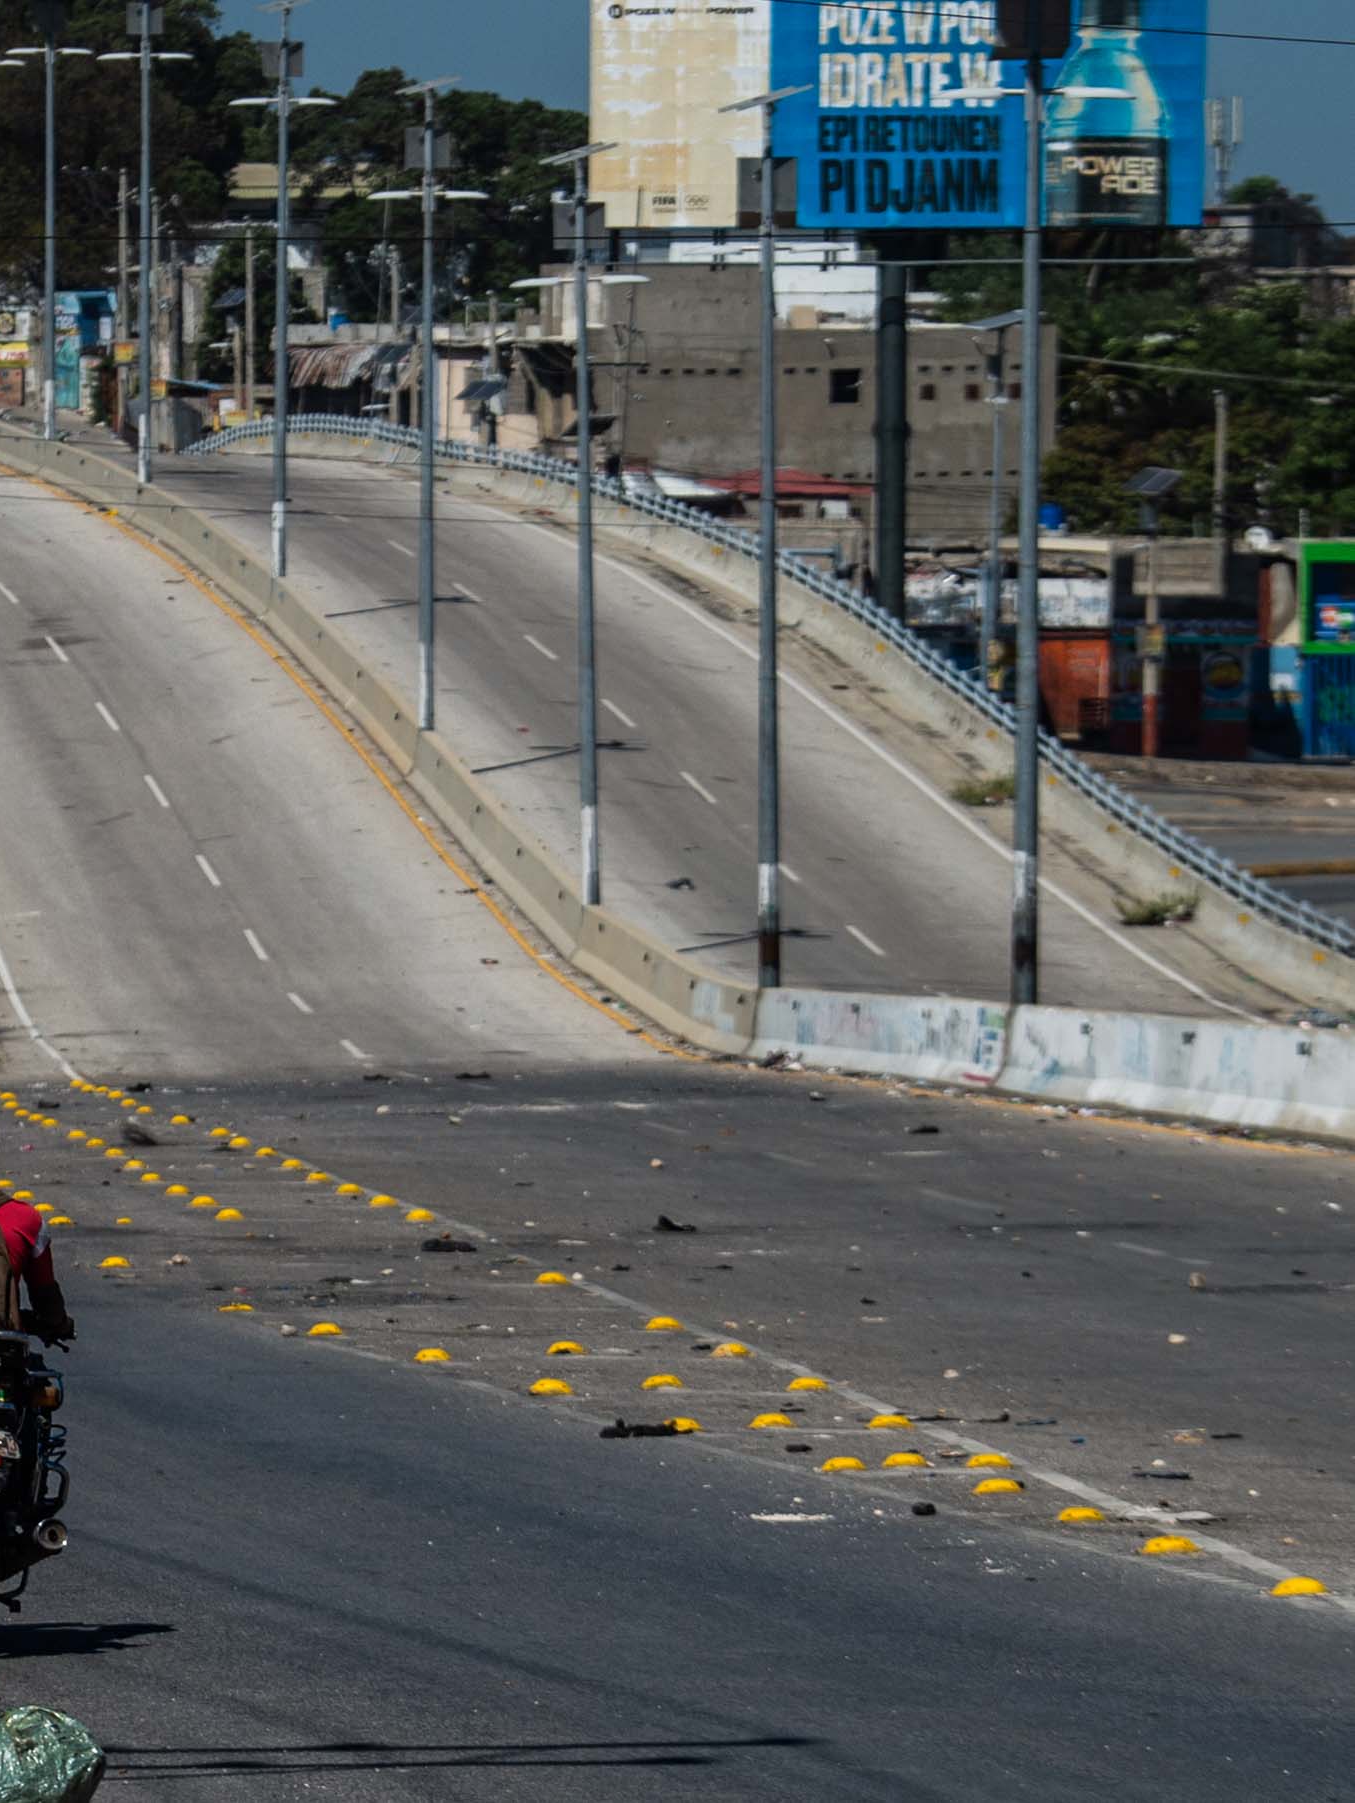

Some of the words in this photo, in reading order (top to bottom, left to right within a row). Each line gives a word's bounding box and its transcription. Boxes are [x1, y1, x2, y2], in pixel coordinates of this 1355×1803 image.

[819, 1, 895, 45] POZE
[902, 1, 933, 45] W
[819, 53, 952, 108] IDRATE
[959, 53, 1003, 108] W
[819, 115, 858, 152] EPI
[863, 115, 1002, 152] RETOUNEN
[1062, 156, 1158, 175] POWER
[1101, 174, 1158, 194] ADE
[820, 159, 855, 213] PI
[865, 159, 1001, 213] DJANM
